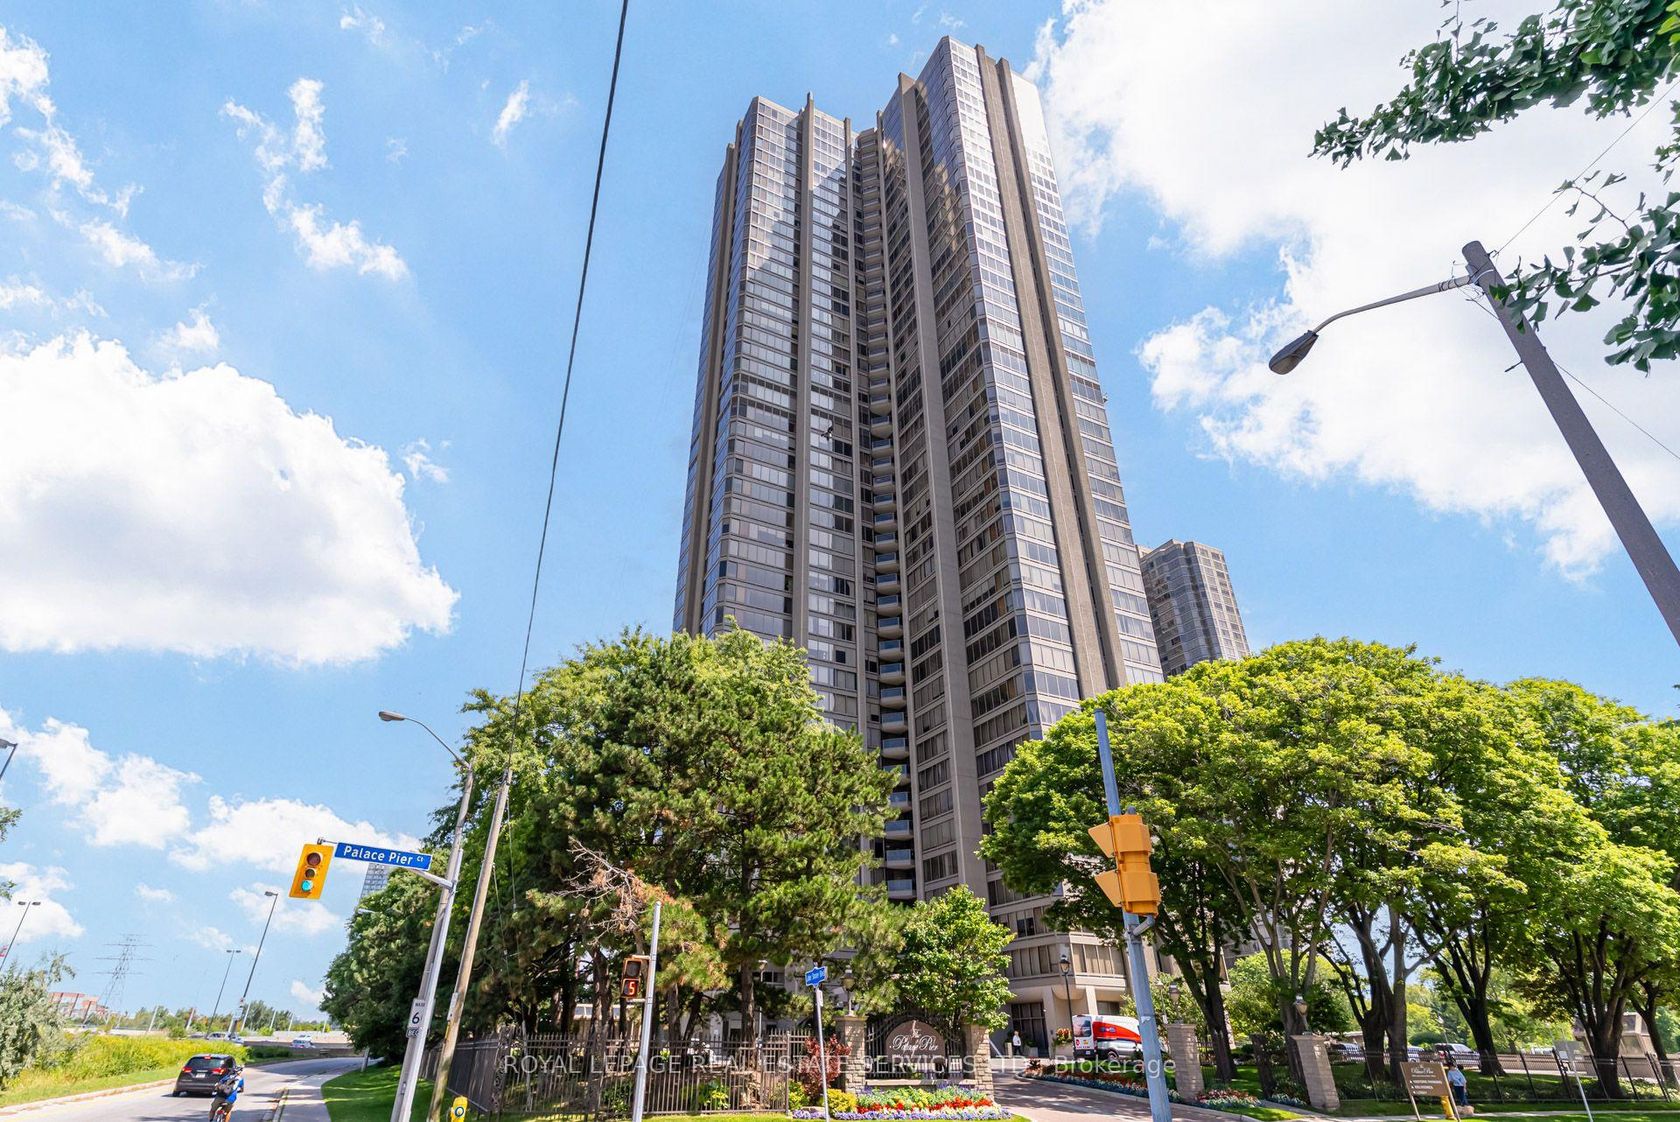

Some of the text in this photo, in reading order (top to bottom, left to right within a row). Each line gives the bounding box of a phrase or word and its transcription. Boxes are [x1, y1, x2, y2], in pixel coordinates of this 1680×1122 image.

[344, 845, 385, 861] Palace
[388, 852, 413, 865] Pier
[629, 981, 635, 996] 5
